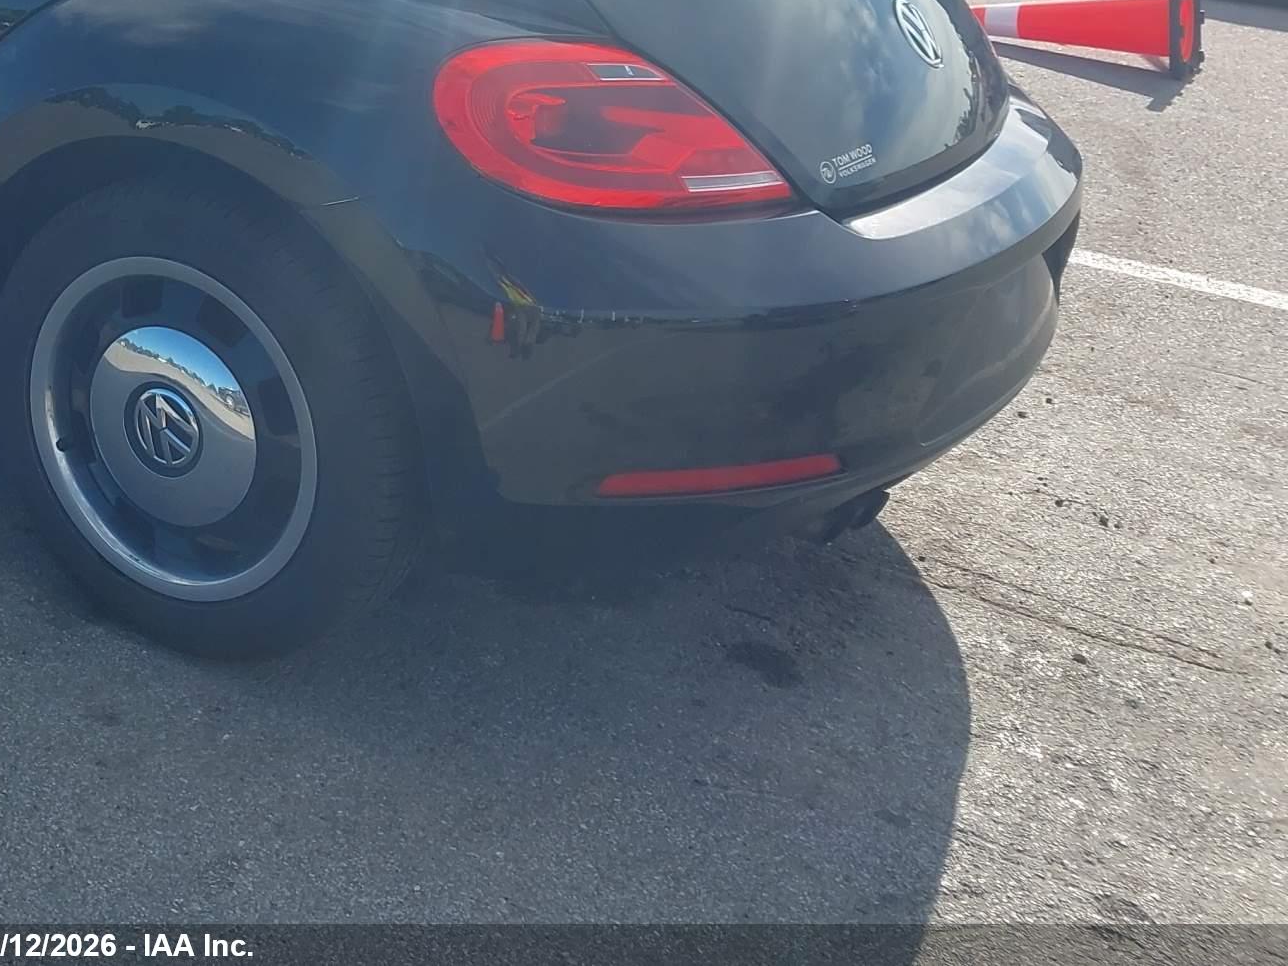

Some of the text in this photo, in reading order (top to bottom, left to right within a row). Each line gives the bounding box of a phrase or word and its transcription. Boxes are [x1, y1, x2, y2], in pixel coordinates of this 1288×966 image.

[832, 144, 873, 167] TOM WOOD
[839, 158, 876, 178] VOLKSWAGEN
